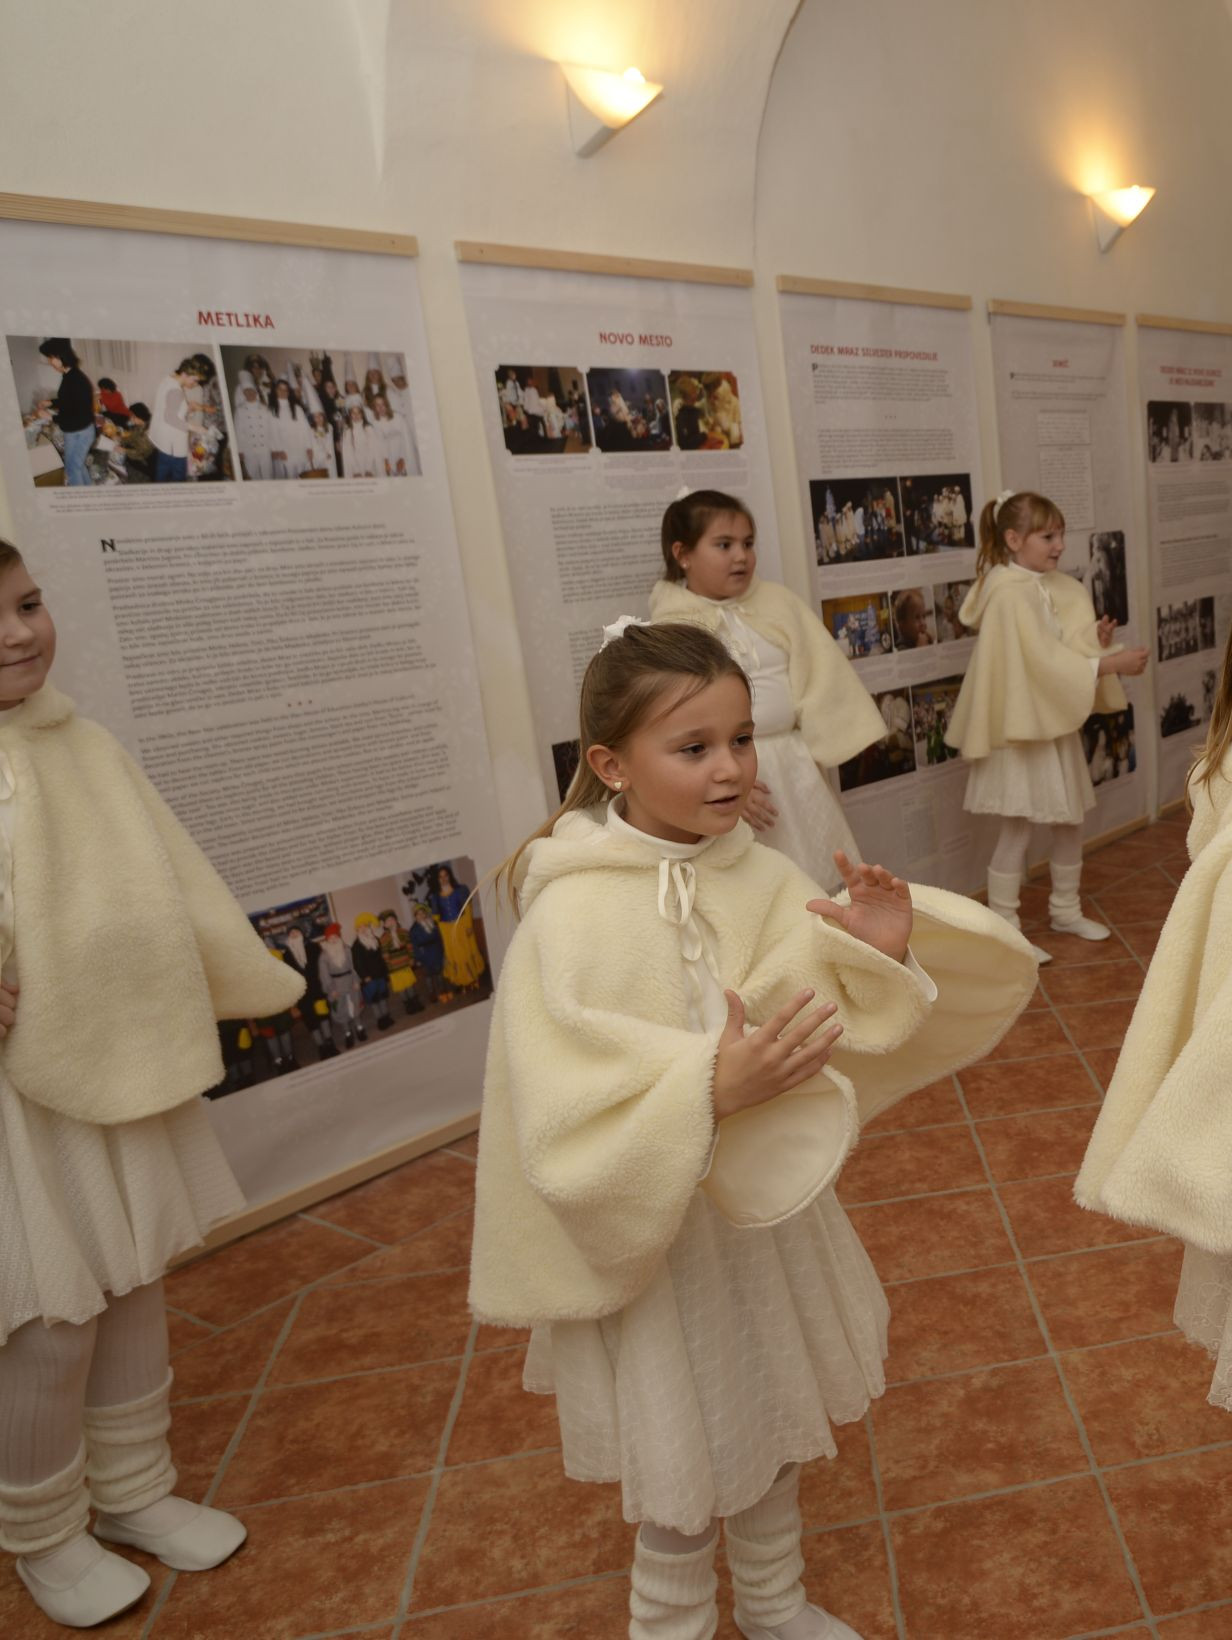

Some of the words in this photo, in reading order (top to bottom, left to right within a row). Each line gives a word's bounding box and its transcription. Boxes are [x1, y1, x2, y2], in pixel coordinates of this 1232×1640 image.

[198, 310, 275, 329] METLIKA
[599, 332, 635, 346] NOVO
[639, 334, 673, 348] MESTO
[811, 345, 835, 356] DEDEK
[838, 346, 859, 357] MRAZ
